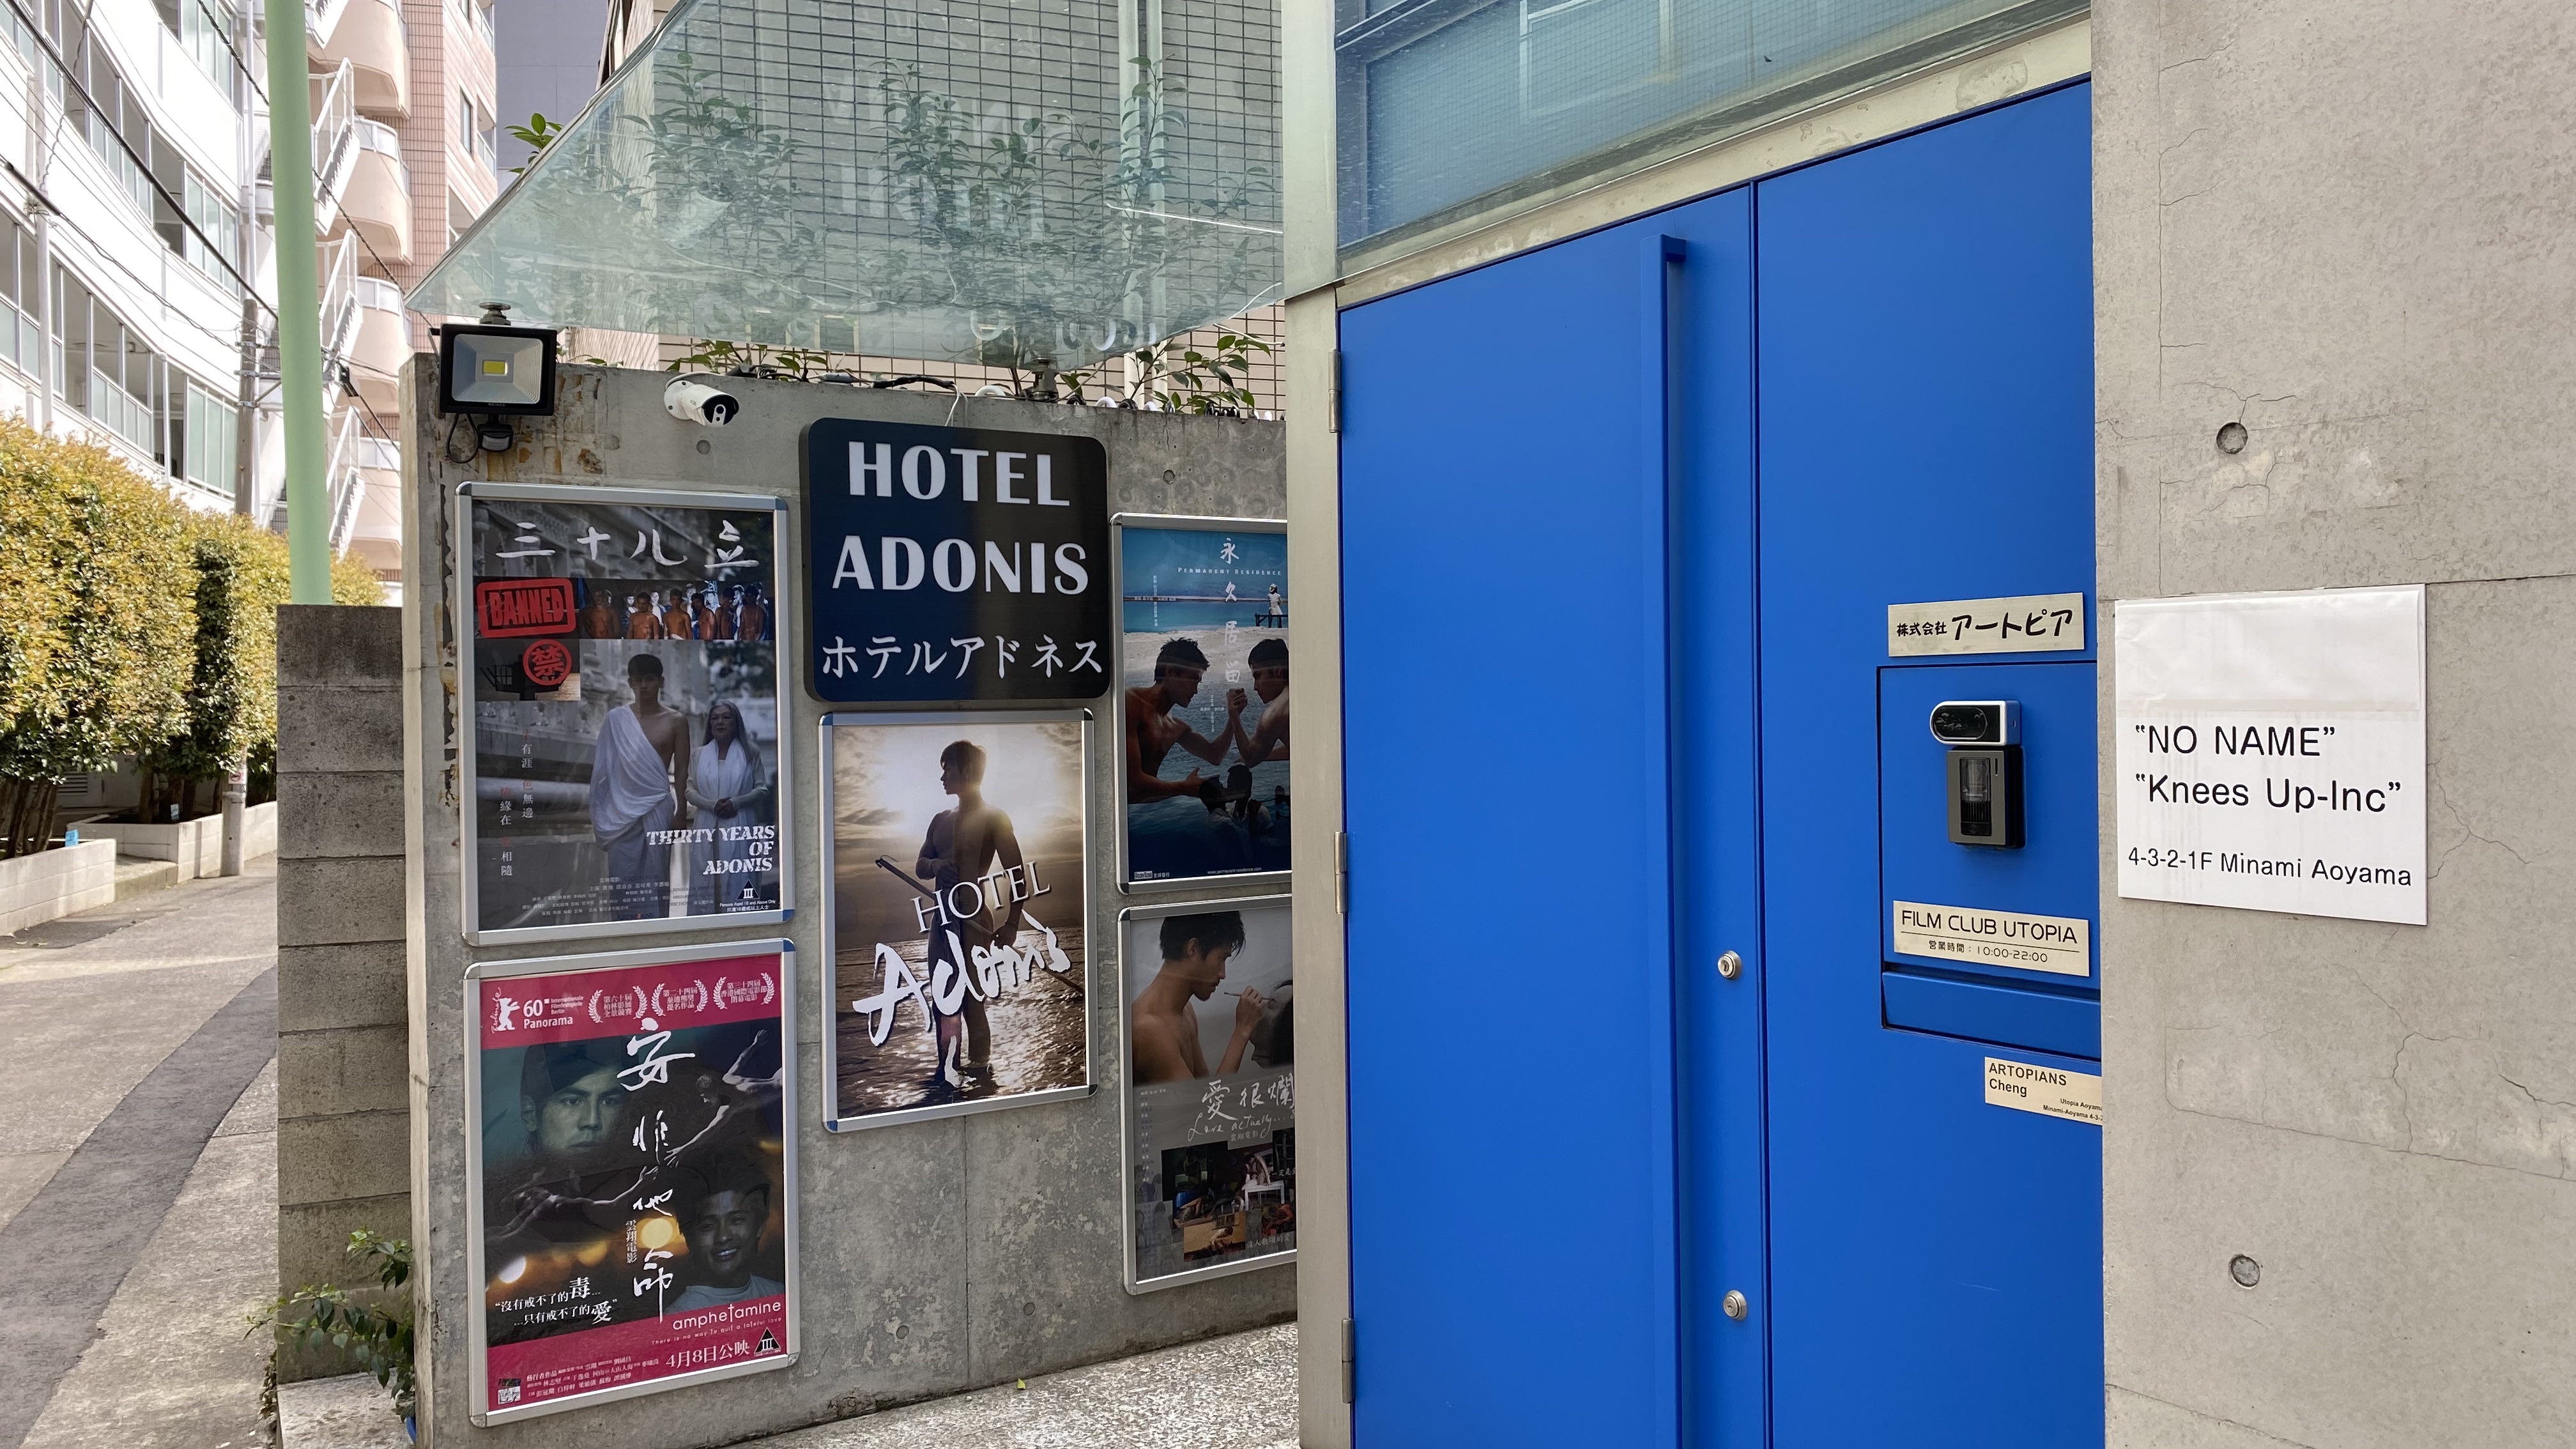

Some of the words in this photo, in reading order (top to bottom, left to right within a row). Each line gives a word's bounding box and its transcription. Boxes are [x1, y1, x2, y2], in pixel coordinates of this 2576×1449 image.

[848, 441, 1070, 507] HOTEL
[832, 535, 1089, 595] ADONIS
[489, 587, 565, 627] BANNED
[1896, 622, 1947, 638] 株式会社
[1951, 608, 2073, 641] アートピア
[530, 645, 566, 680] 禁
[822, 634, 1103, 680] ホテルアドネス
[646, 828, 716, 846] THIRTY
[719, 825, 776, 841] YEARS
[749, 841, 775, 856] OF
[702, 857, 773, 875] ADONIS
[2128, 847, 2213, 871] 4-3-2-1F
[2220, 852, 2301, 878] Minami
[2311, 859, 2412, 886] Aoyama
[910, 861, 1051, 933] HOTEL
[1901, 909, 1942, 930] FILM
[1948, 915, 1997, 935] CLUB
[2004, 920, 2078, 944] UTOPIA
[1977, 947, 2048, 963] 10:00-22:00
[550, 995, 584, 1004] Internationale
[523, 1016, 574, 1029] Panorama
[1988, 1062, 2067, 1086] ARTOPIANS
[1989, 1078, 2028, 1098] Cheng
[2043, 1104, 2088, 1117] Minami-Aoyama
[2060, 1098, 2079, 1107] Utopia
[1188, 1112, 1225, 1142] Love
[673, 1301, 781, 1330] amphetamine
[720, 1324, 733, 1333] quit
[666, 1339, 751, 1369] 4月8日公映
